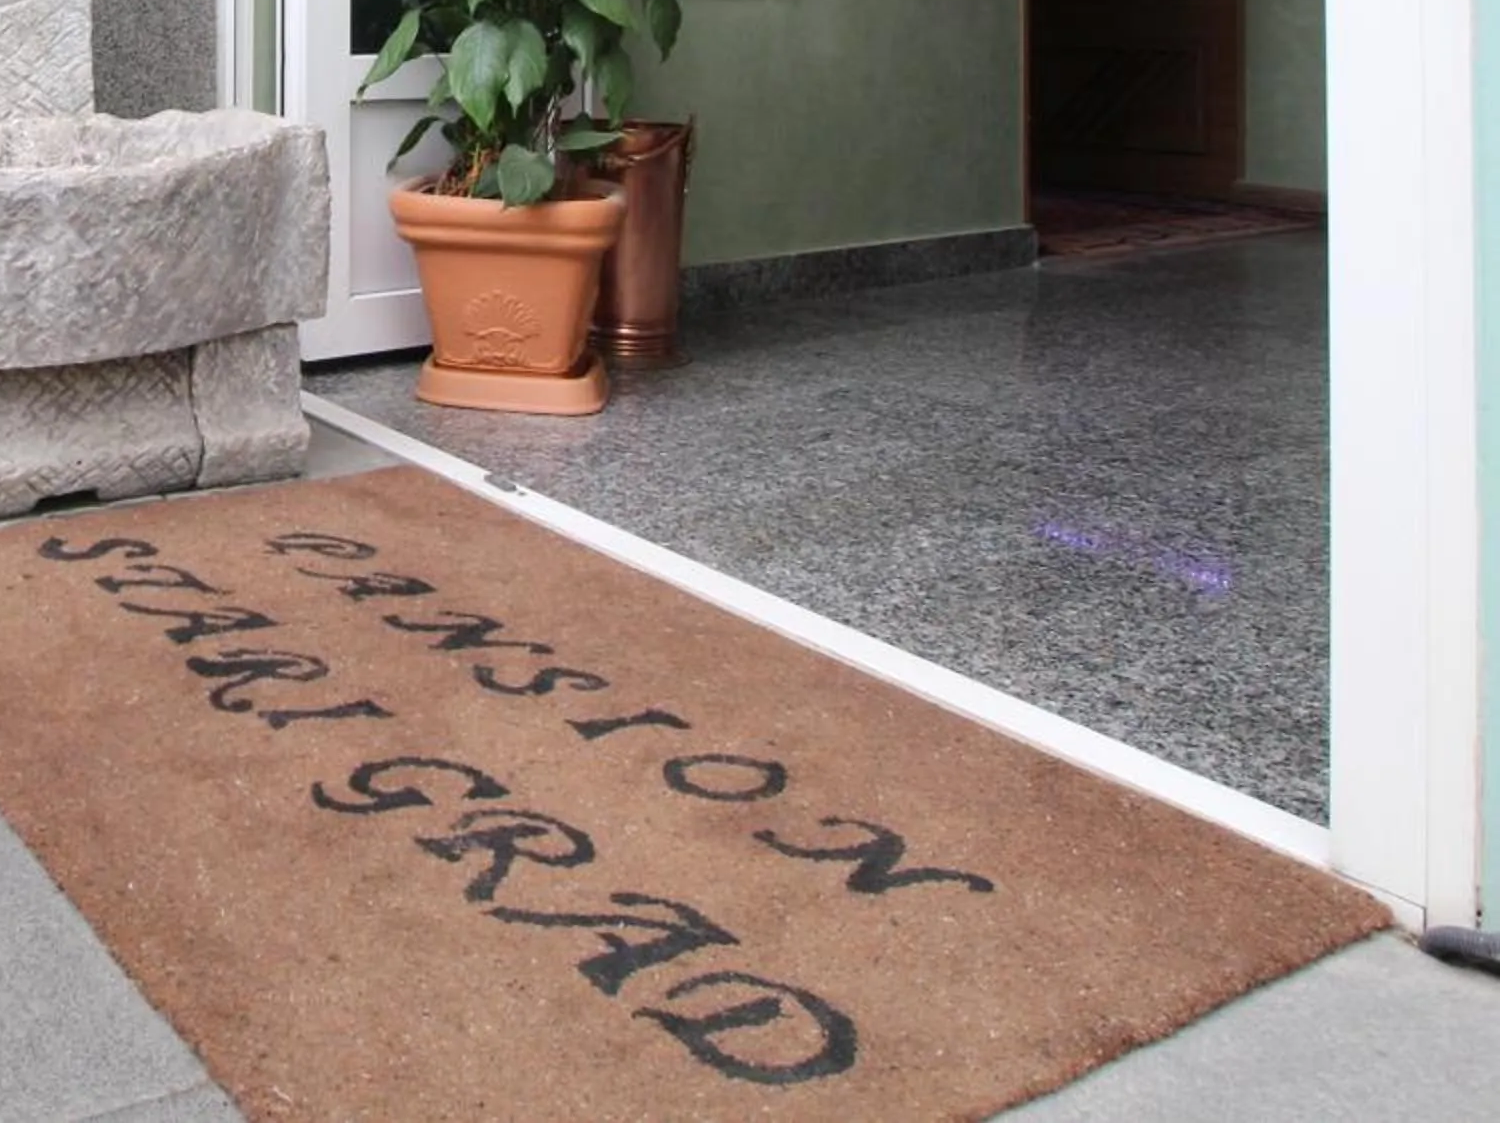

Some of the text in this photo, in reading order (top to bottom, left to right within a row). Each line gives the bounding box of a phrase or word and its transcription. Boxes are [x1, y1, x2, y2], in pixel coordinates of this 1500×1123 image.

[41, 535, 858, 1085] STARI GRAD
[263, 532, 993, 895] PANSION
